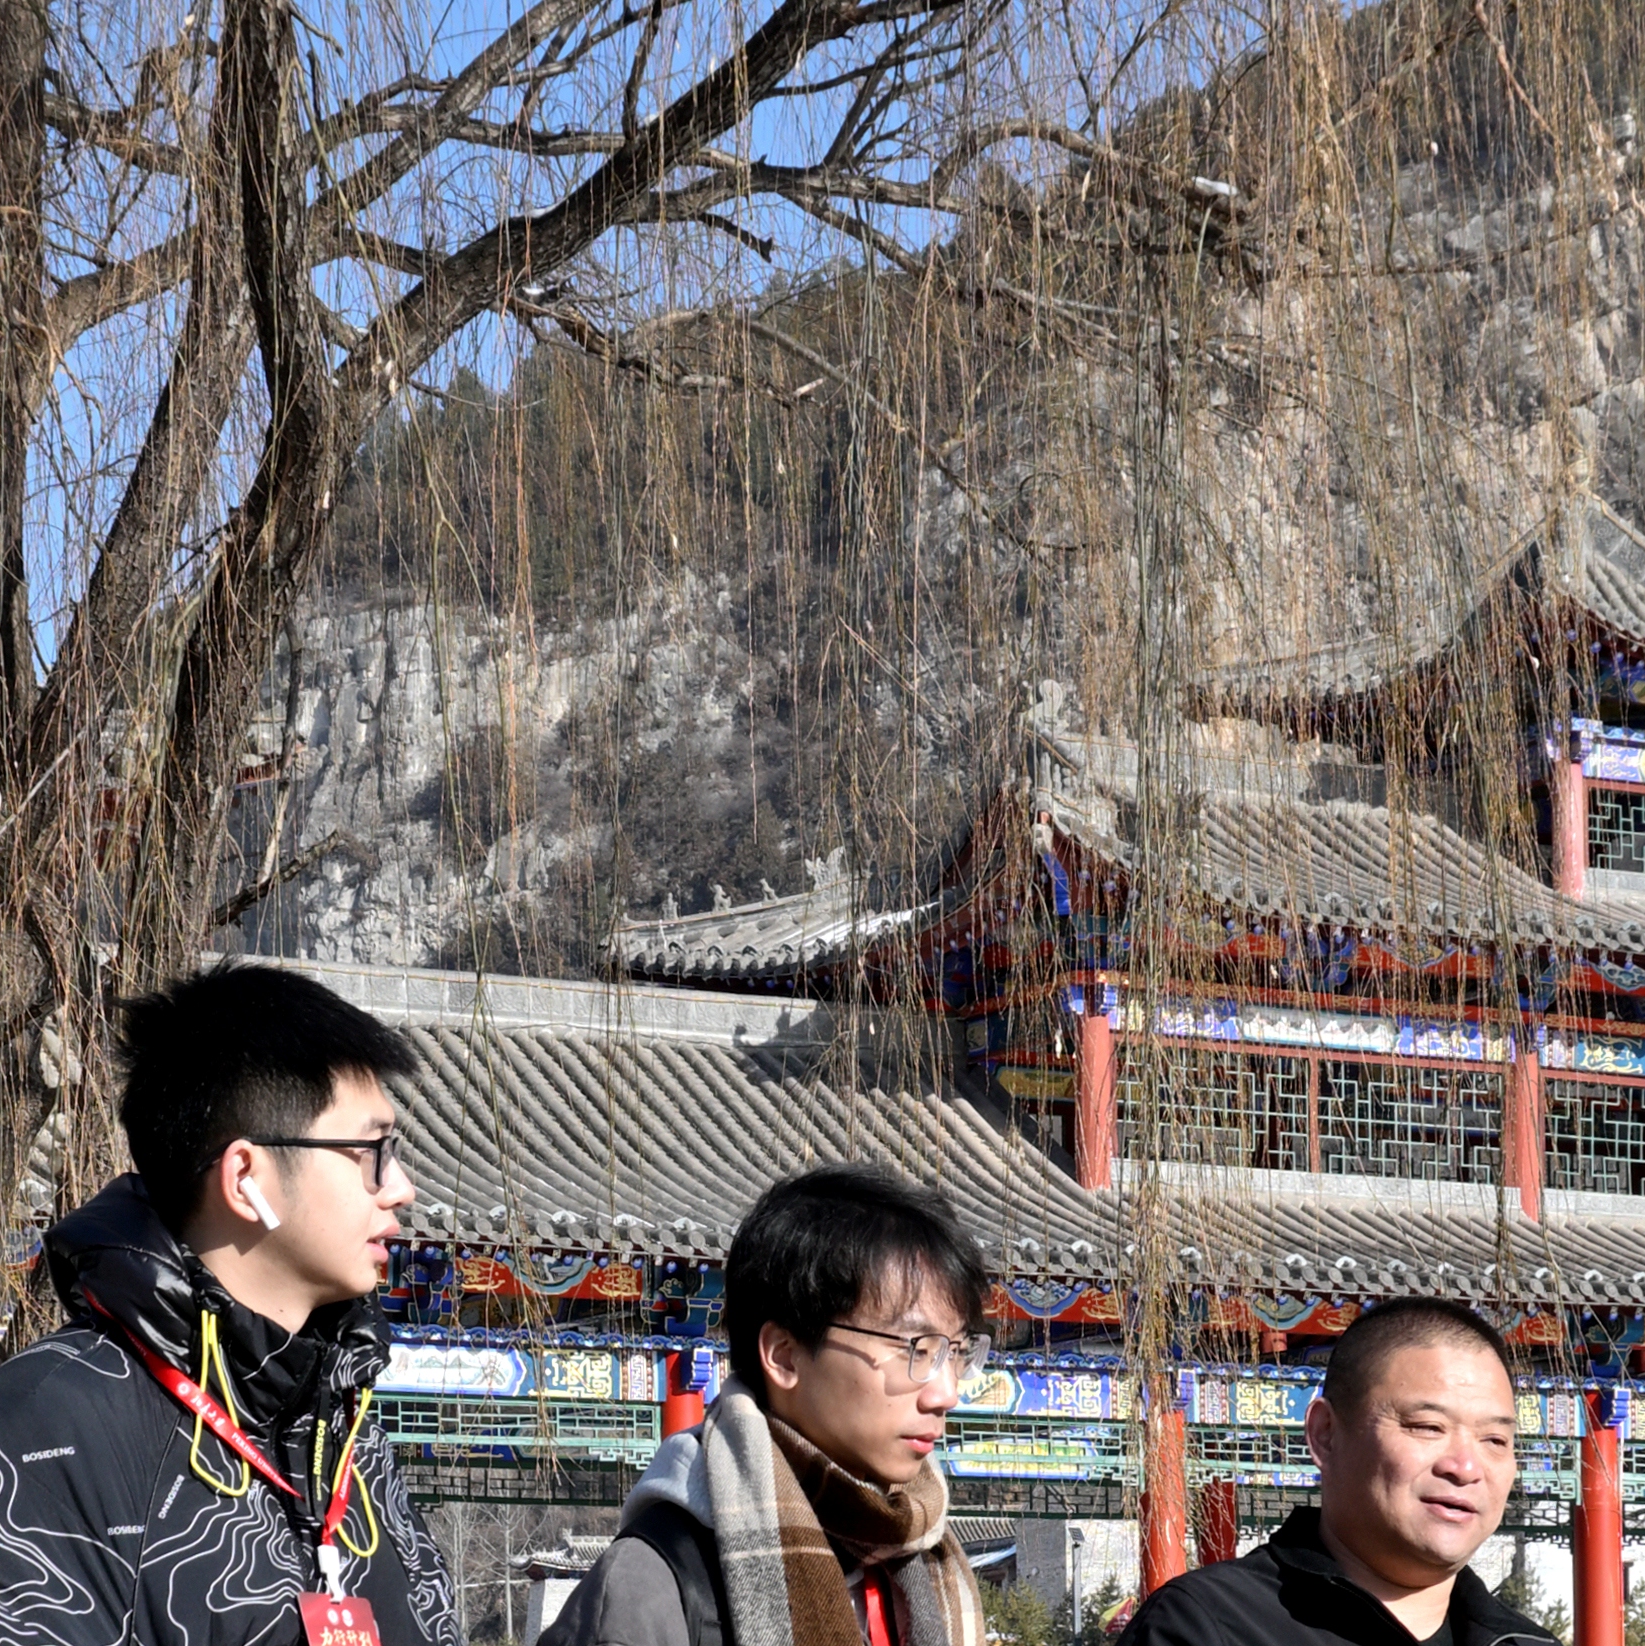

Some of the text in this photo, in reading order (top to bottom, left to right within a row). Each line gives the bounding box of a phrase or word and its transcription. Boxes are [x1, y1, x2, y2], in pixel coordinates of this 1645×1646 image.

[22, 1446, 75, 1463] BOSIDENG
[313, 1419, 327, 1475] BOSIDENG
[157, 1474, 185, 1520] BOSIDENG
